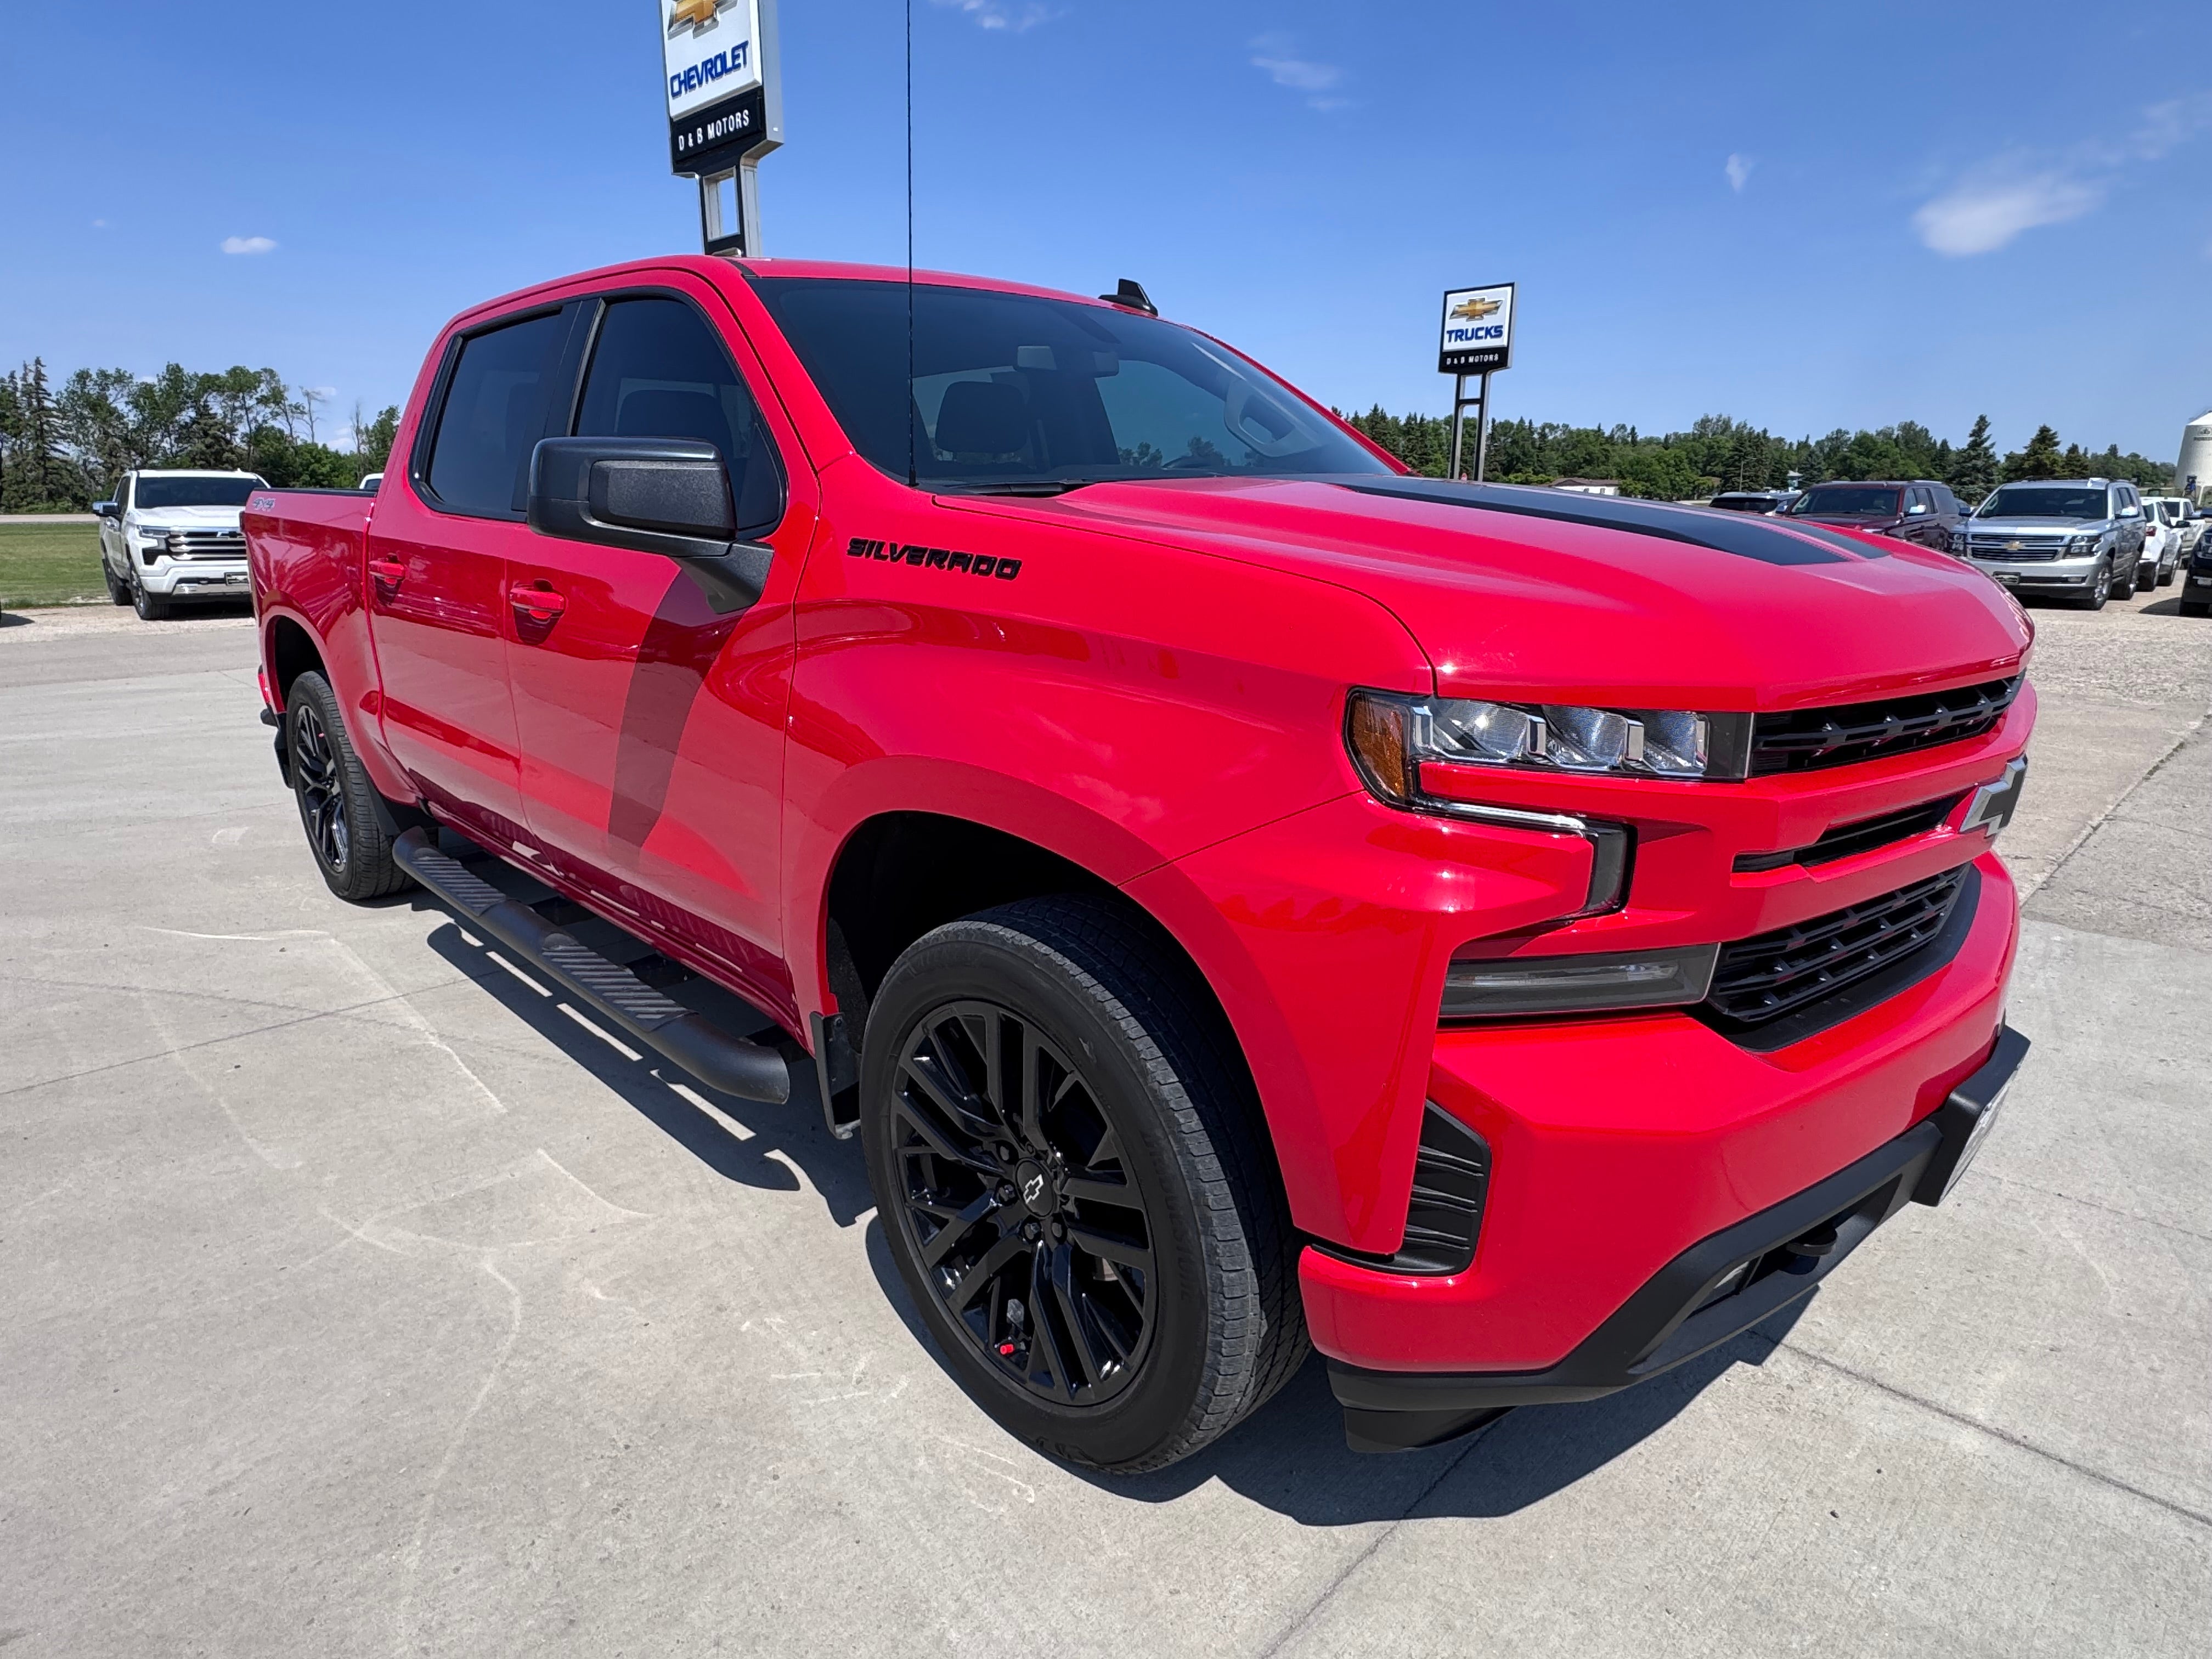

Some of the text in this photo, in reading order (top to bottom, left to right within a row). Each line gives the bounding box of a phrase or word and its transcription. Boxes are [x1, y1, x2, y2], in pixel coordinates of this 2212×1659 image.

[670, 40, 749, 98] CHEVROLET
[678, 109, 750, 151] D & B MOTORS
[1447, 325, 1503, 343] TRUCKS
[1468, 353, 1498, 363] MOTORS
[847, 537, 1022, 581] SILVERADO
